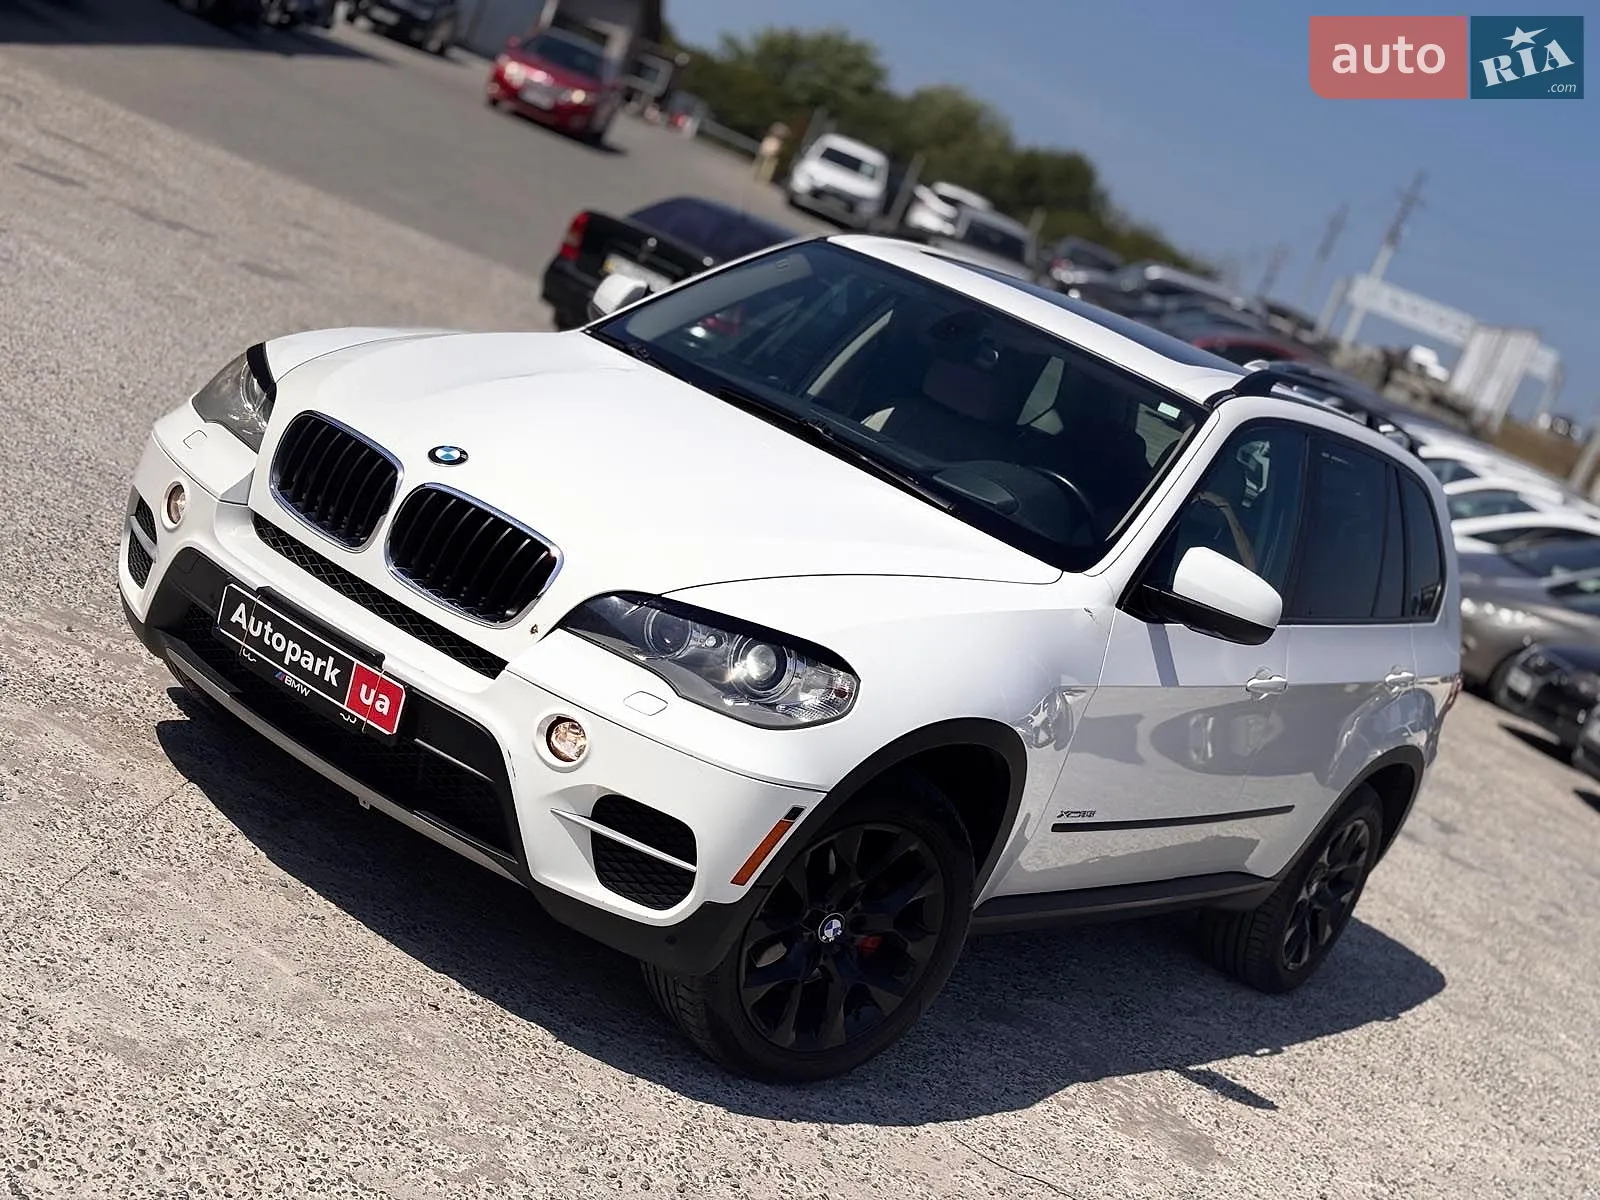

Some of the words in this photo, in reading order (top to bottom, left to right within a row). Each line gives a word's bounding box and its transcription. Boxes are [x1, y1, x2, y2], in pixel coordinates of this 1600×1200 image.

[230, 602, 341, 687] Autopark
[359, 683, 391, 716] ua
[284, 675, 311, 697] BMW
